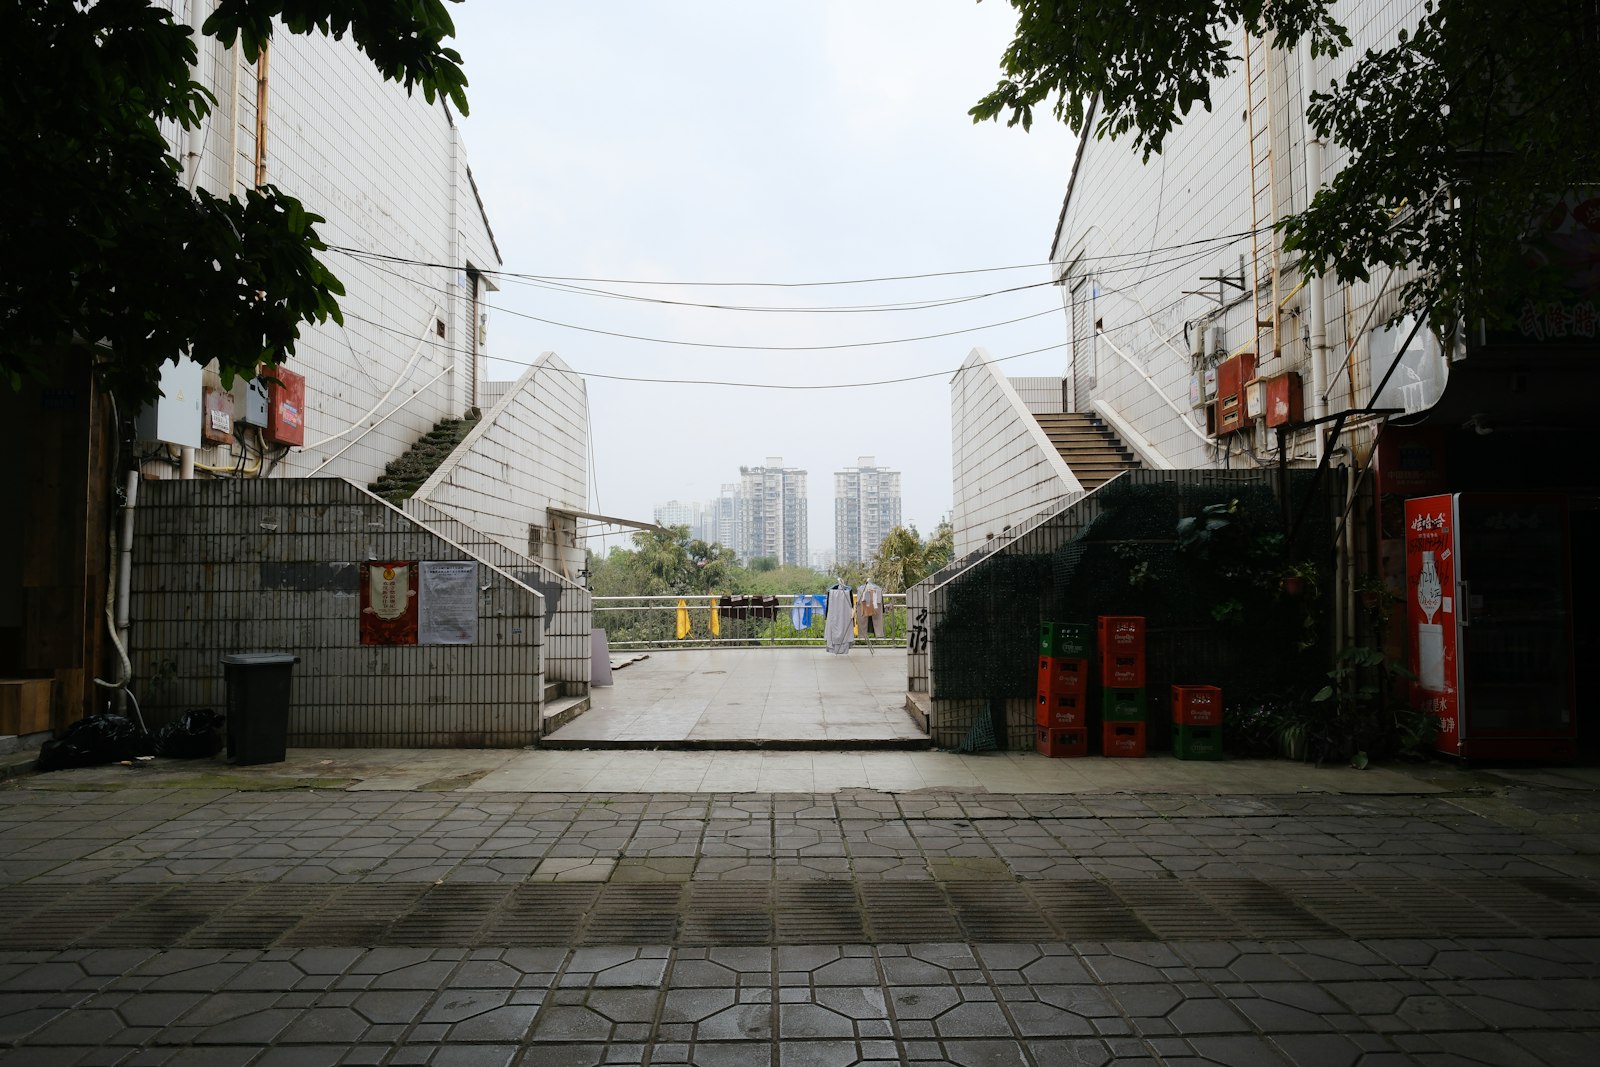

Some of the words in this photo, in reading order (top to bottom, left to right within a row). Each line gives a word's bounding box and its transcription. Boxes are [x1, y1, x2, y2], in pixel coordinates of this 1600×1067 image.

[1518, 297, 1600, 341] 武隆腊
[1410, 512, 1446, 531] 娃哈哈
